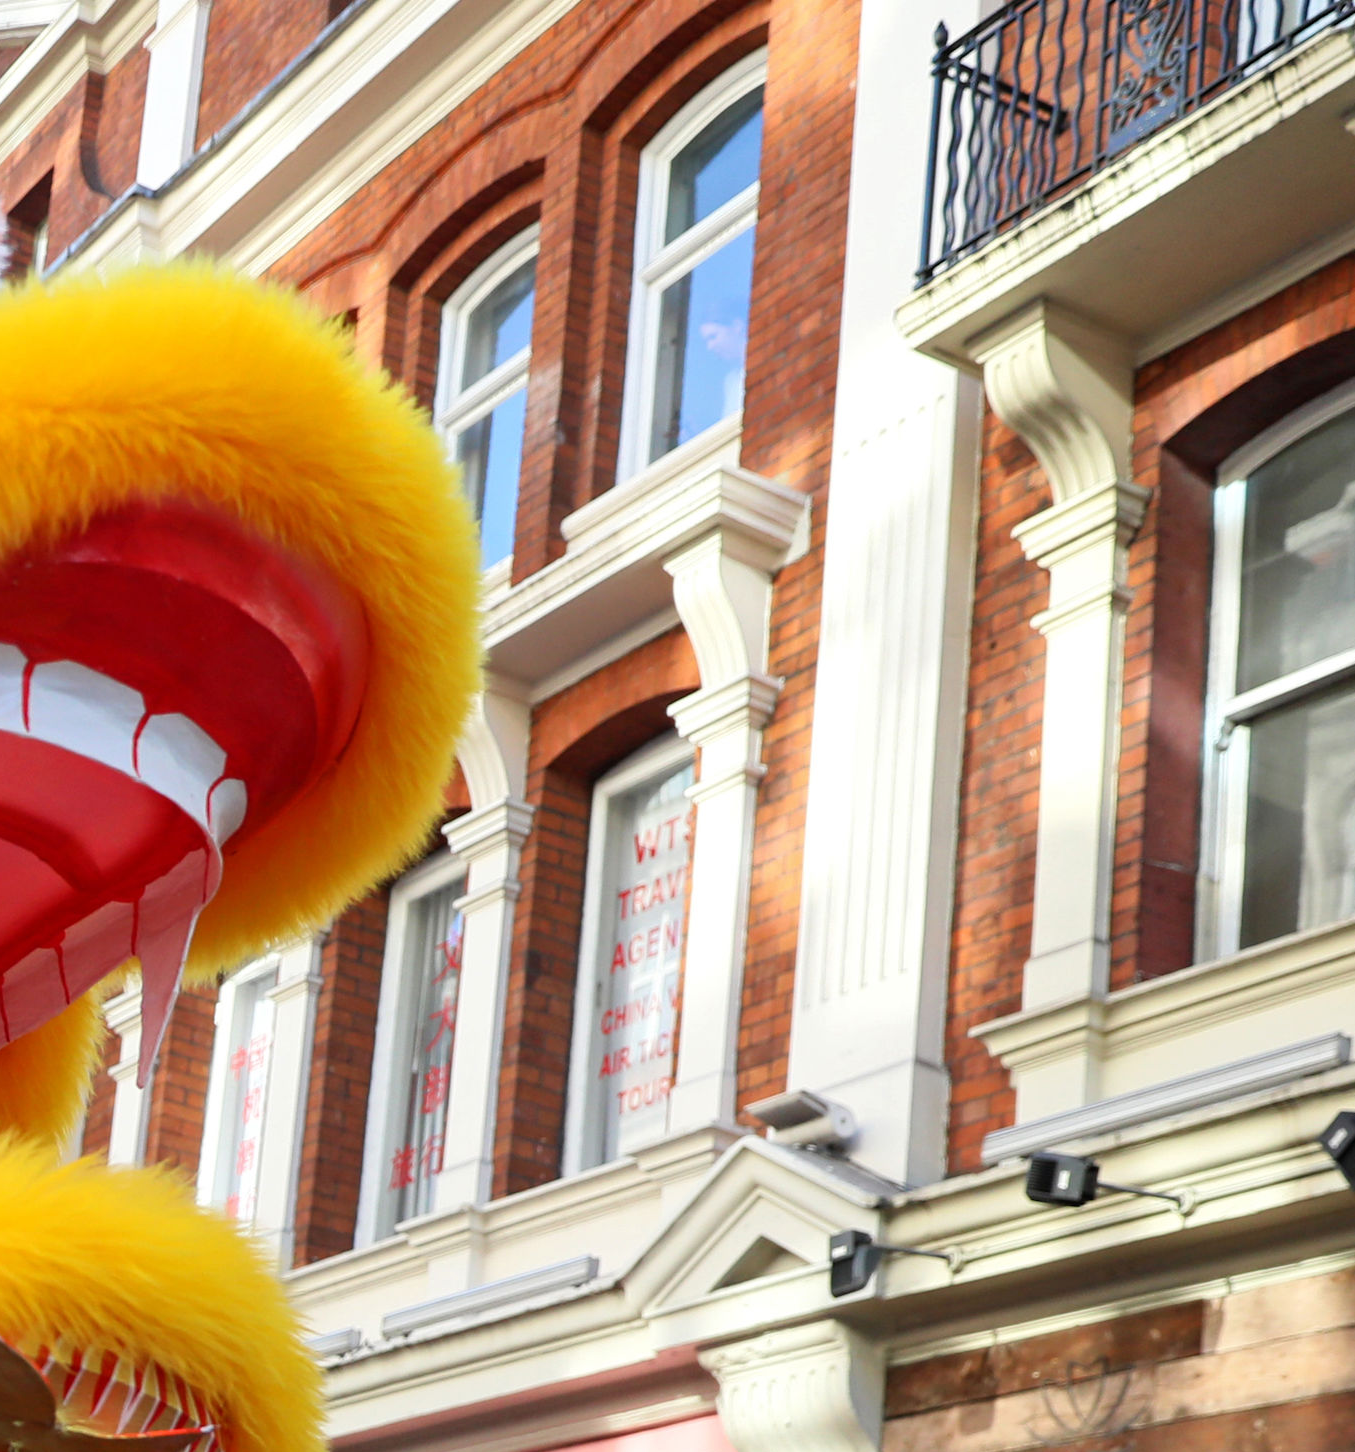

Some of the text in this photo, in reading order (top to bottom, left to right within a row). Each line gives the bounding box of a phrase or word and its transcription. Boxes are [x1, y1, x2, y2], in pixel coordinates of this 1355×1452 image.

[618, 866, 688, 920] TRAV
[610, 919, 681, 974] AGEN
[598, 1045, 632, 1080] AIR
